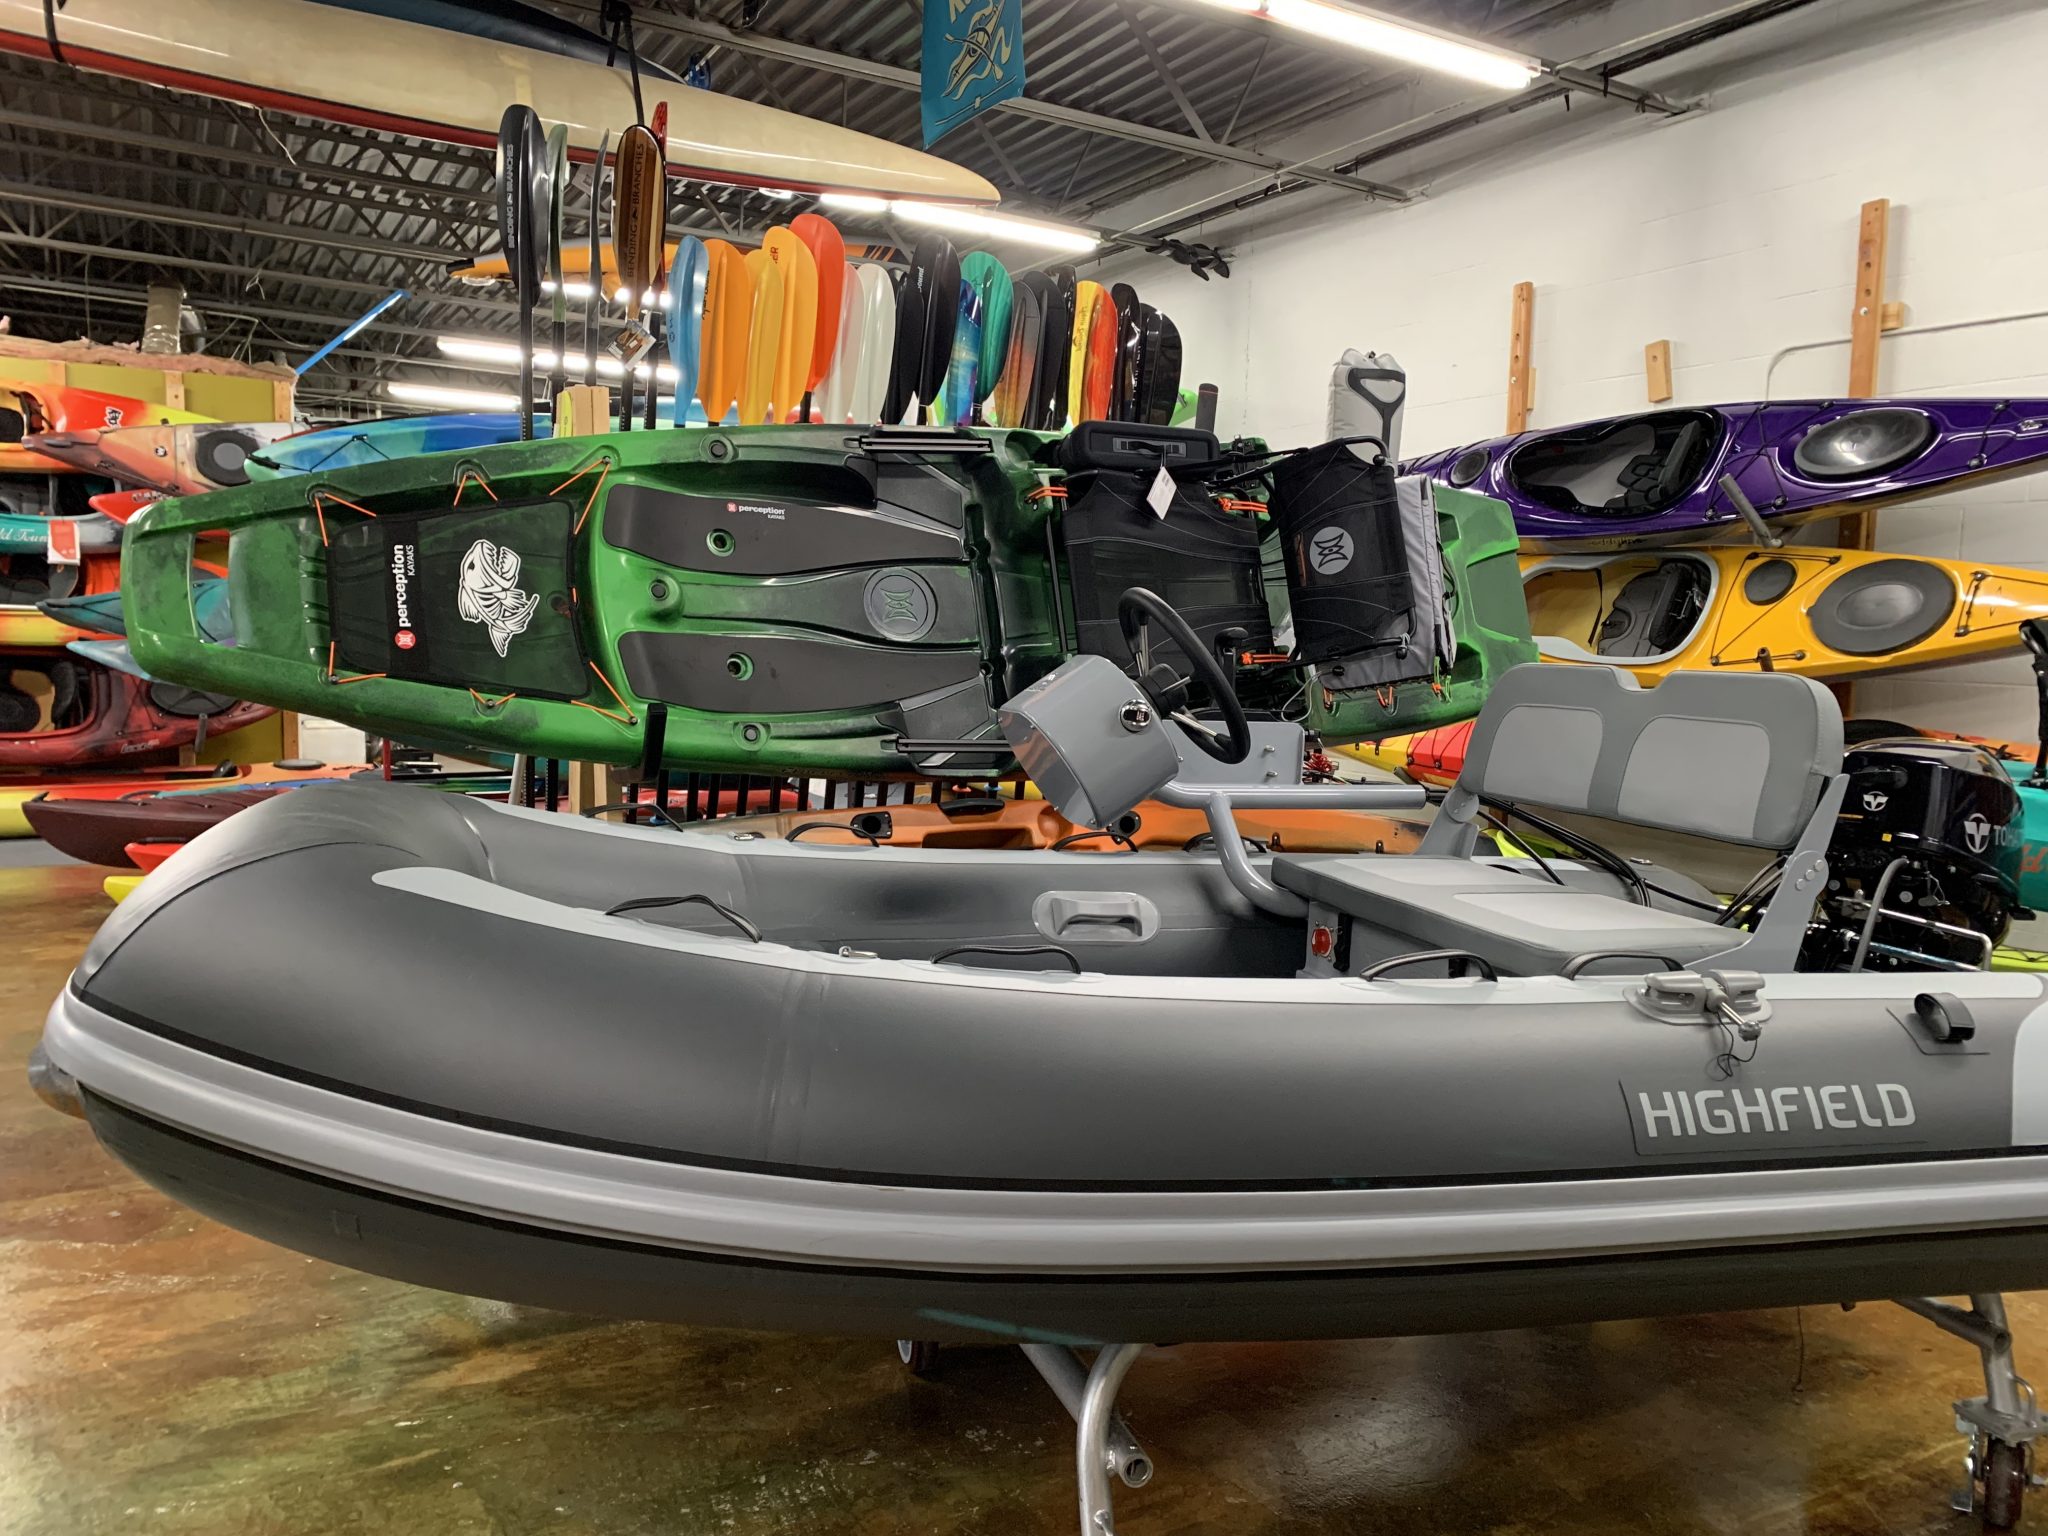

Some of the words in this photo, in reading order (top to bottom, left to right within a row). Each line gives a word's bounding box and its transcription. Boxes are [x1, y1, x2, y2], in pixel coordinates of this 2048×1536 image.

[506, 143, 514, 194] BRANCHES
[632, 143, 645, 205] BRANCHES
[507, 207, 515, 249] BENDING
[627, 224, 638, 278] BENDING
[738, 505, 785, 515] perception
[391, 544, 411, 628] perception
[406, 544, 415, 576] KAYAKS
[1638, 1083, 1916, 1138] HIGHFIELD
